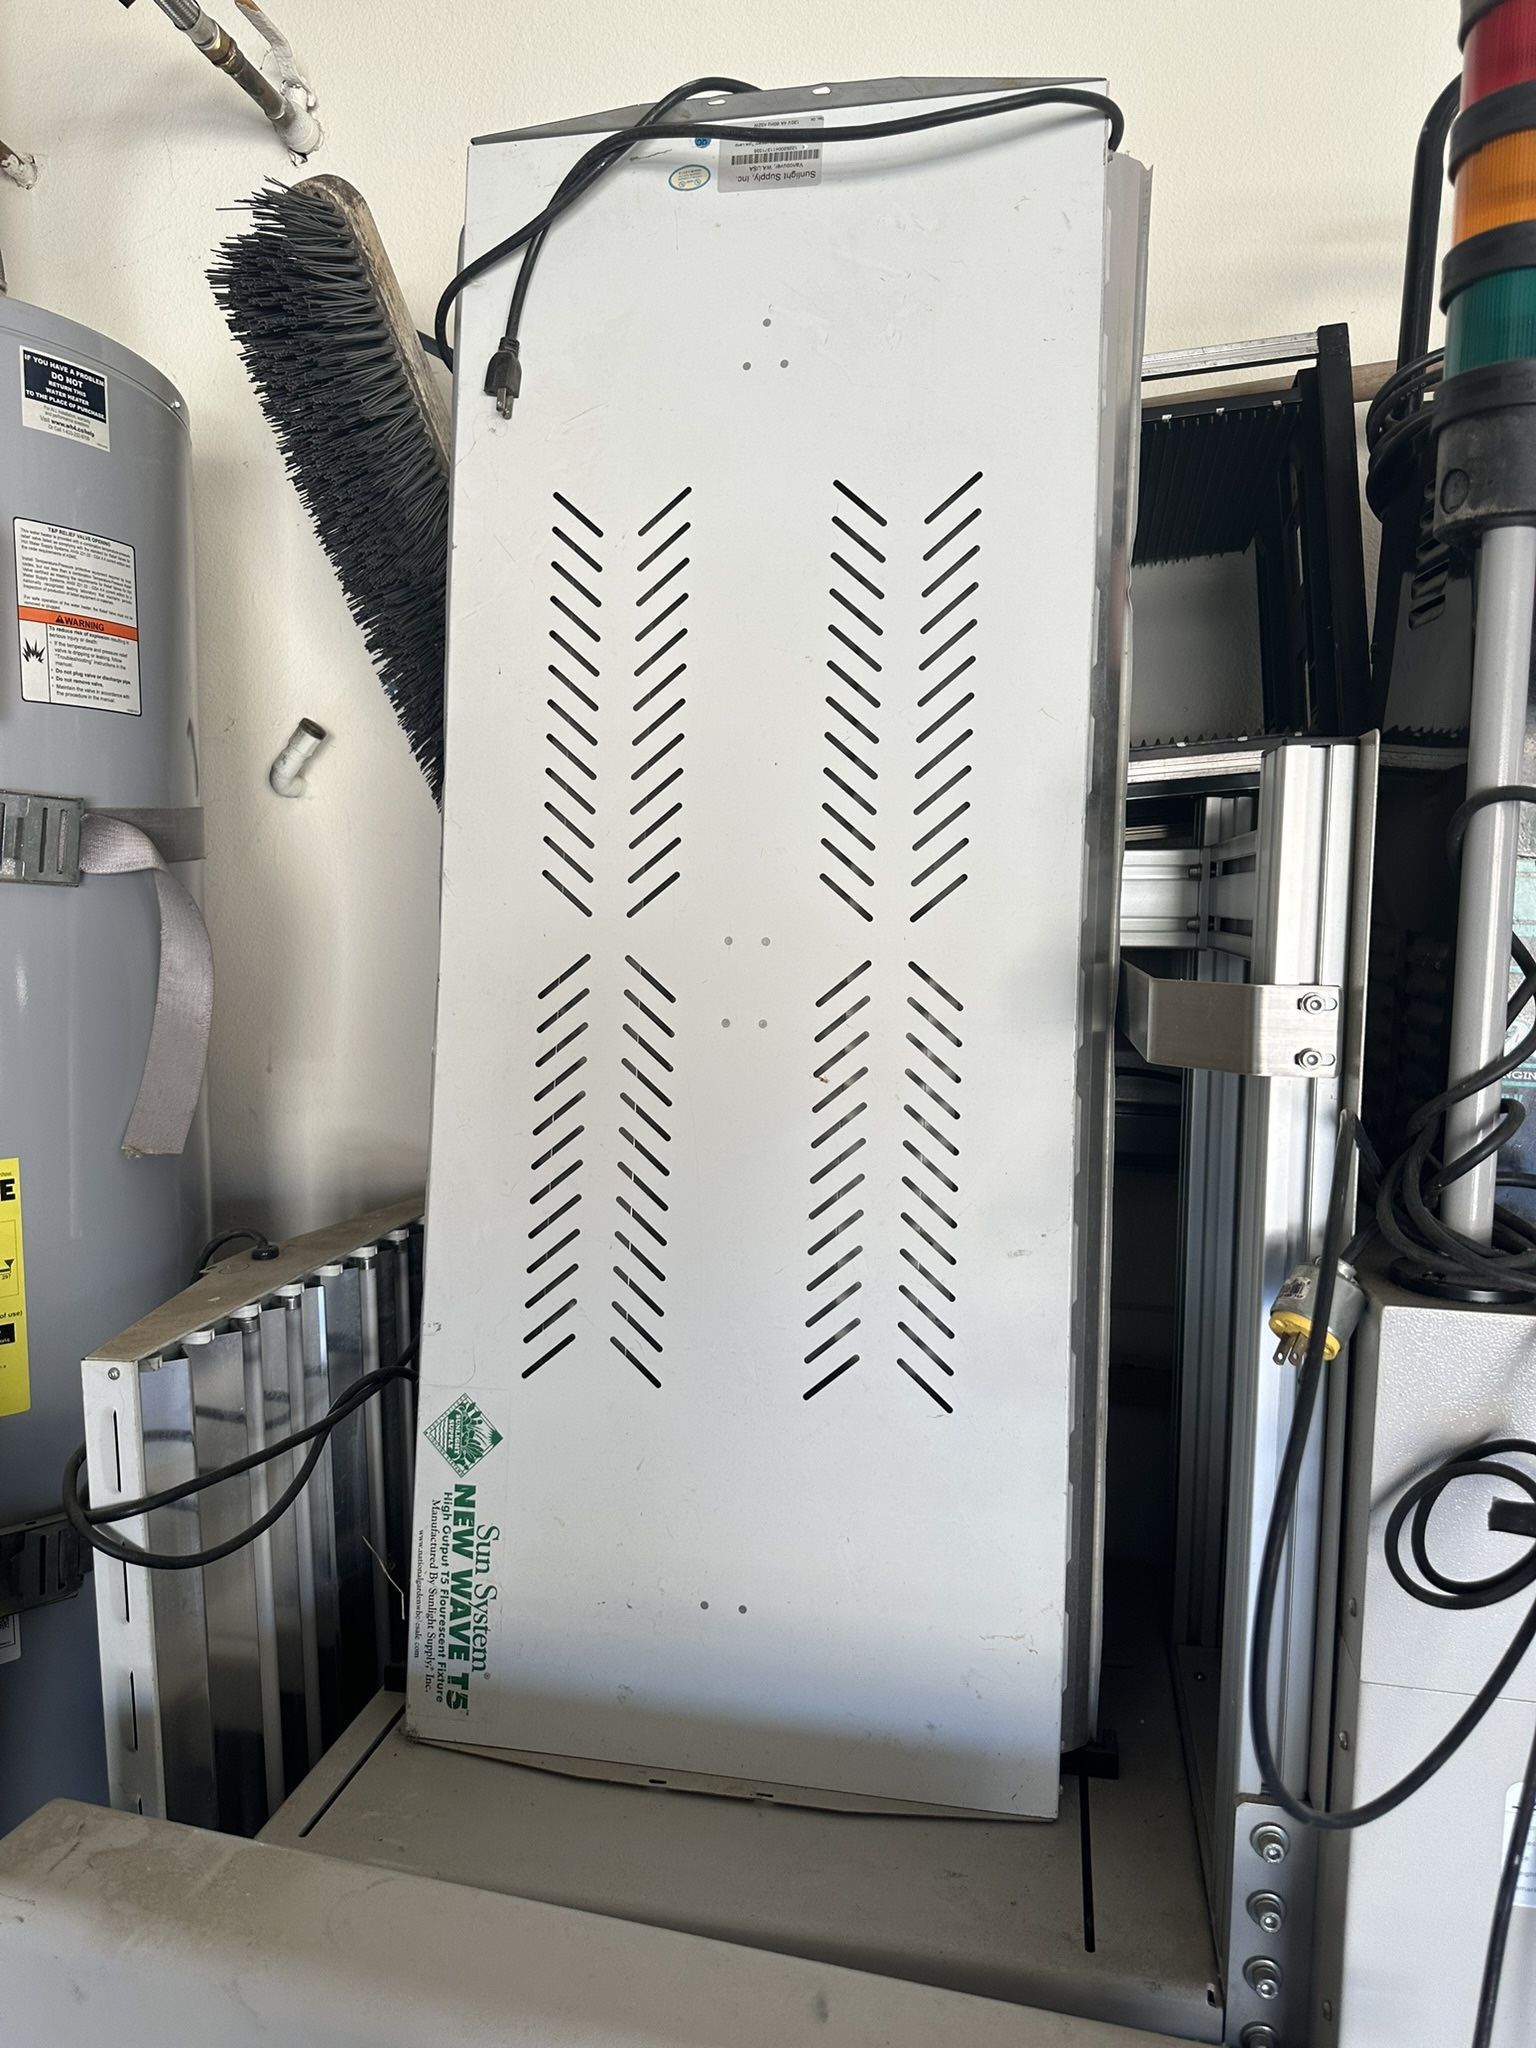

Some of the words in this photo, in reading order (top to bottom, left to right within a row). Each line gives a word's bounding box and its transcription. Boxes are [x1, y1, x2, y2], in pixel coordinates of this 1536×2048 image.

[736, 175, 749, 183] Inc.
[752, 172, 781, 182] Supply,
[783, 171, 816, 181] Sunlight
[33, 357, 48, 367] YOU
[50, 362, 69, 373] HAVE
[76, 371, 104, 386] PROBLEM
[51, 371, 64, 382] DO
[66, 376, 83, 388] NOT
[45, 387, 66, 398] WATER
[67, 394, 89, 406] HEATER
[48, 380, 72, 393] RETURN
[73, 389, 87, 398] THIS
[36, 392, 48, 401] THE
[49, 396, 67, 407] PLACE
[69, 402, 76, 410] OF
[59, 529, 75, 538] RELIEF
[77, 534, 91, 542] VALVE
[92, 537, 111, 547] OPENING
[56, 626, 73, 634] reduce
[65, 616, 104, 631] WARNING
[73, 678, 90, 686] remove
[102, 675, 122, 684] discharge
[441, 1492, 453, 1521] High
[451, 1484, 476, 1560] NEW
[428, 1499, 441, 1569] Manufactured
[439, 1524, 451, 1567] Output
[475, 1524, 501, 1575] Sun
[428, 1571, 439, 1586] By
[440, 1571, 450, 1584] T5
[425, 1588, 438, 1629] Sunlight
[448, 1567, 473, 1660] WAVE
[437, 1588, 449, 1659] Flourescent
[424, 1673, 435, 1693] Inc.
[436, 1661, 446, 1703] Fixture
